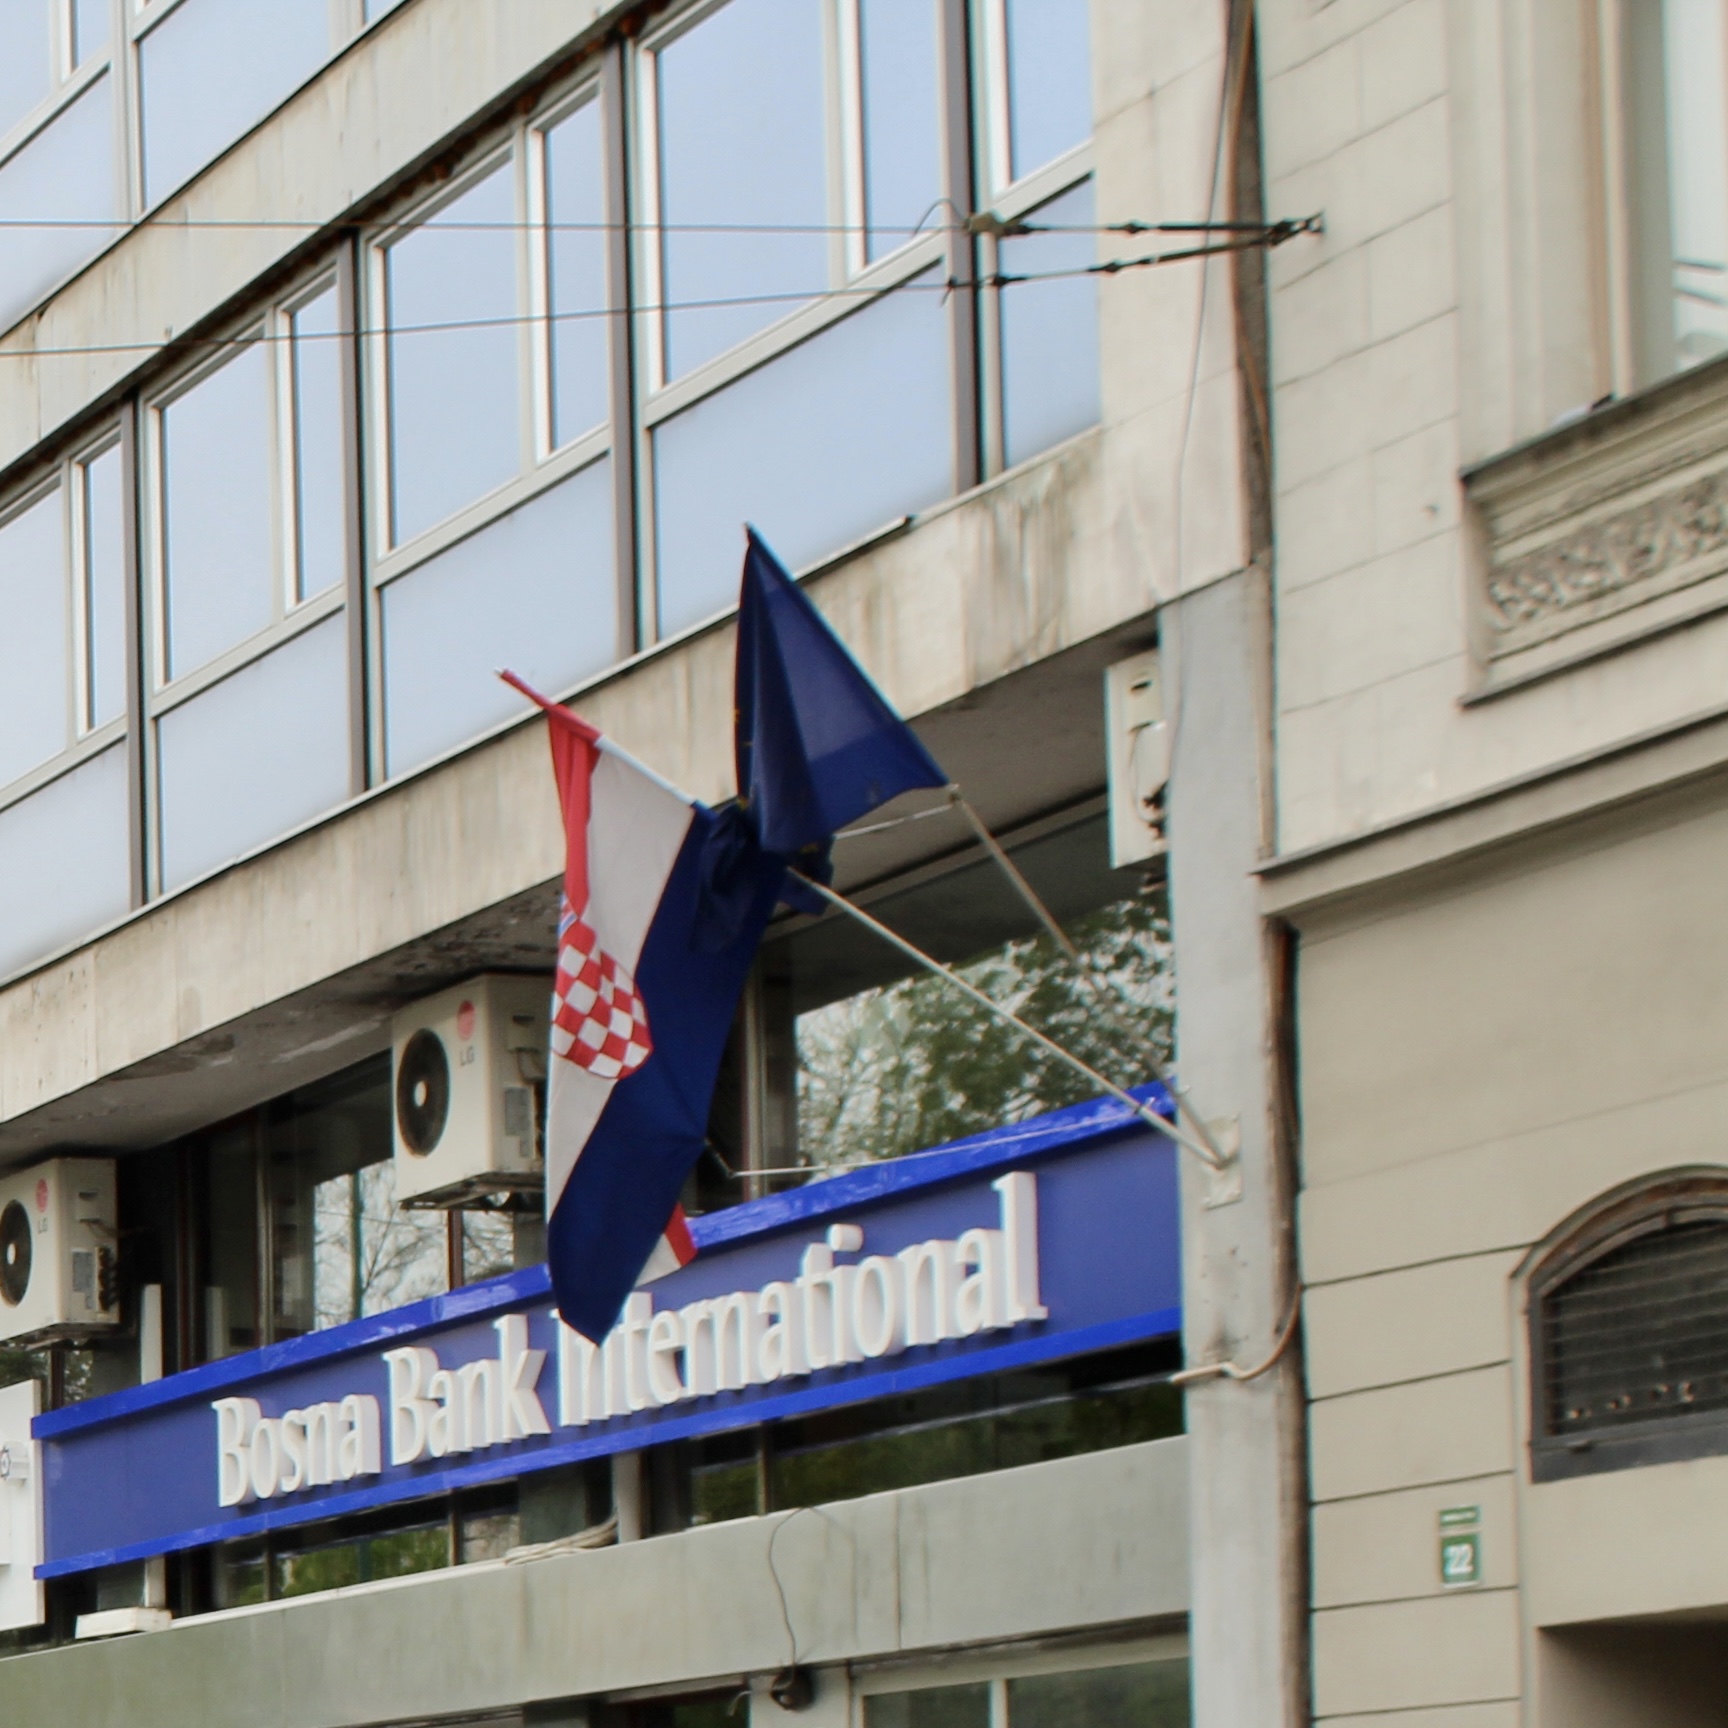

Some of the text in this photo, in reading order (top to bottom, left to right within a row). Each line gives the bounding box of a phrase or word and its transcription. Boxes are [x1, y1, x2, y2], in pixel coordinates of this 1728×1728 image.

[458, 1046, 476, 1067] LG
[212, 1171, 1049, 1507] Bosna Bank International
[1444, 1543, 1475, 1575] 22
